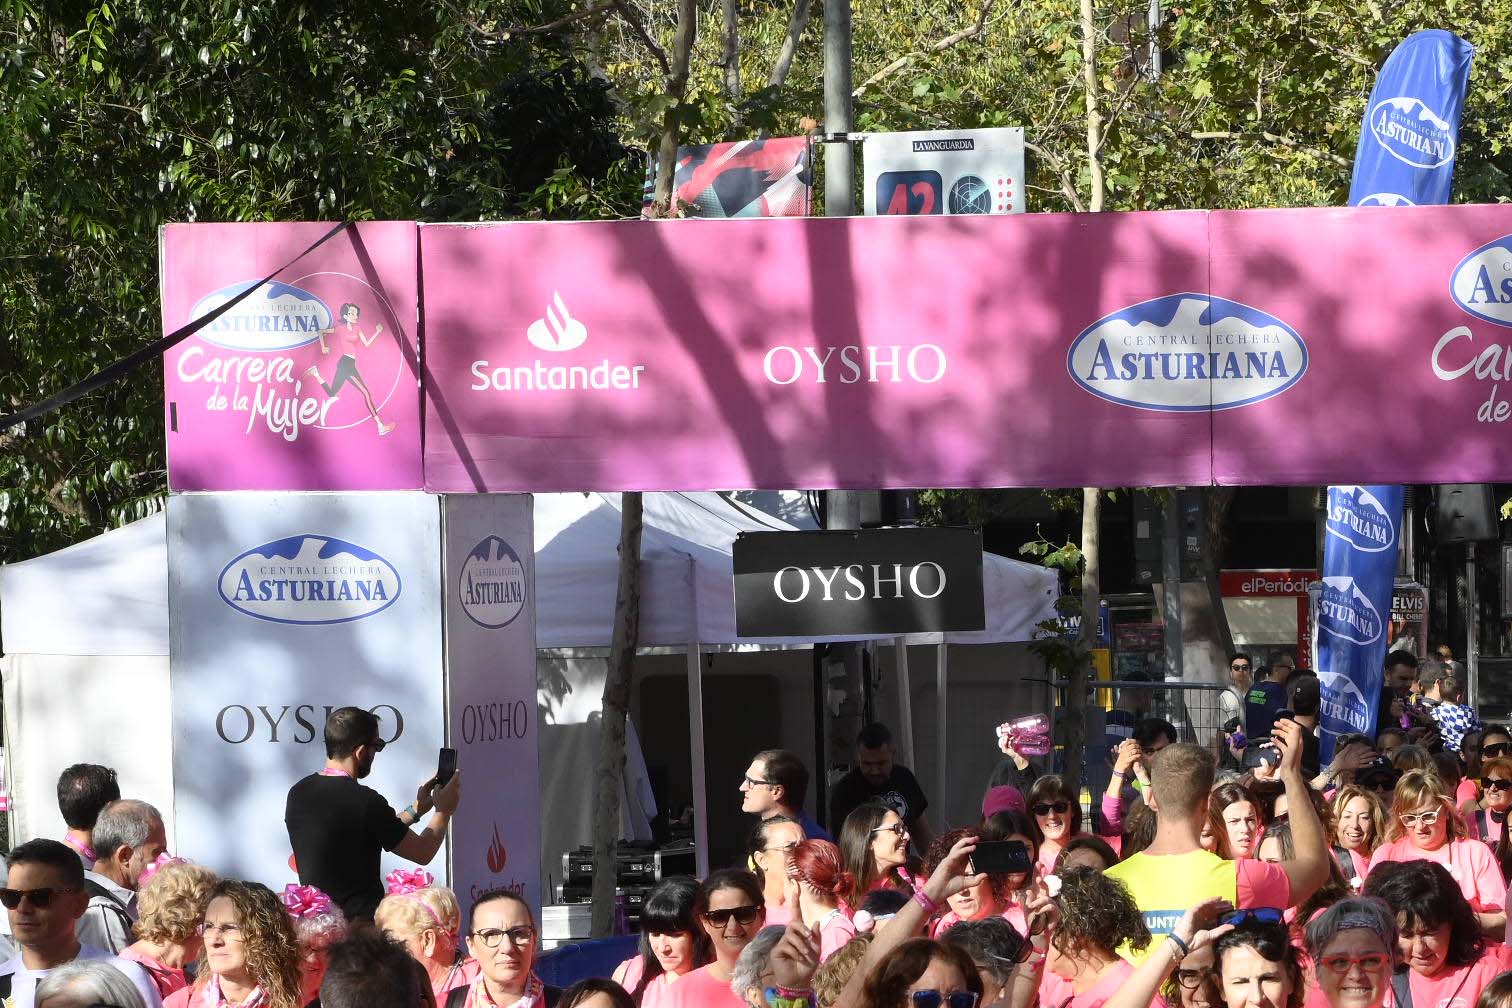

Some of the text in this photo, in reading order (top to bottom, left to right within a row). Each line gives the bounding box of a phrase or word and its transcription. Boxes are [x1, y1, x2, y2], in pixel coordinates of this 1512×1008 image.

[1123, 332, 1281, 346] CENTRAL LECHERA
[177, 346, 295, 385] Carrera
[471, 359, 647, 391] Santander
[763, 343, 947, 385] OYSHO
[1086, 338, 1290, 381] ASTURIANA
[207, 385, 249, 412] de la
[246, 380, 340, 442] Mujer
[1477, 383, 1510, 423] de
[232, 568, 388, 601] ASTURIANA
[260, 566, 382, 575] CENTRAL LECHERA
[465, 570, 522, 605] ASTURIANA
[773, 561, 947, 602] OYSHO
[1393, 597, 1423, 609] ELVIS
[215, 704, 404, 744] OYSO
[462, 700, 528, 745] OYSHO
